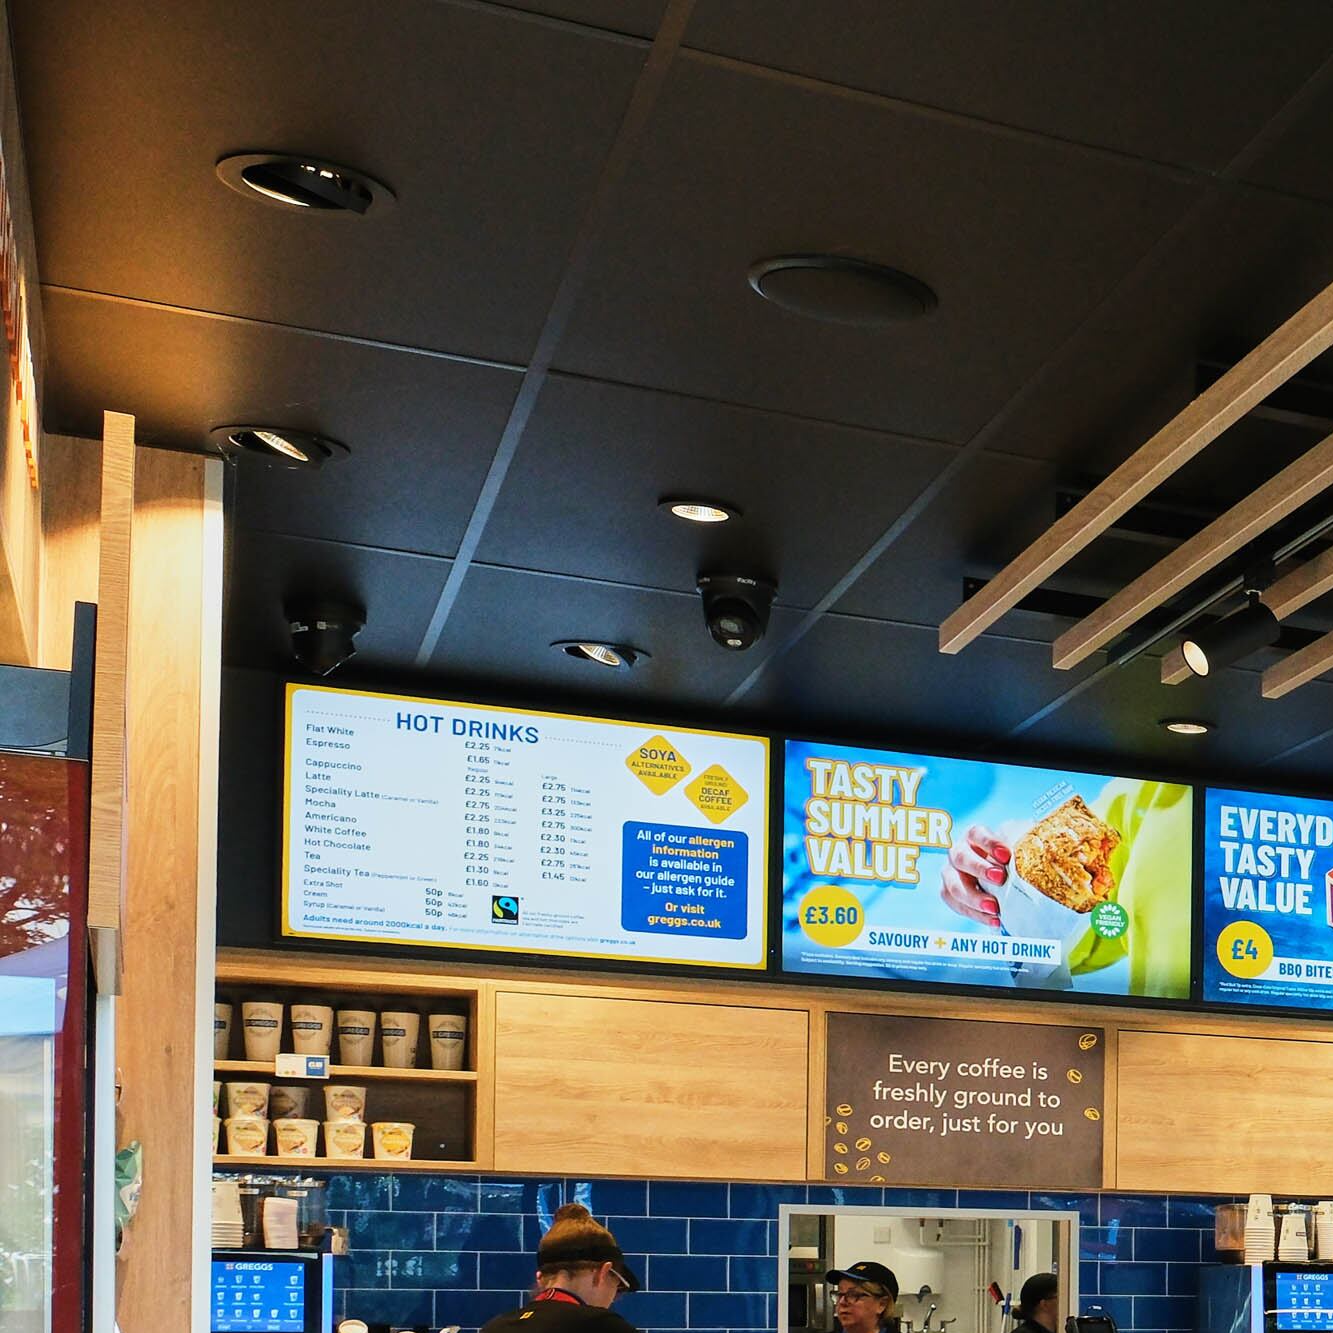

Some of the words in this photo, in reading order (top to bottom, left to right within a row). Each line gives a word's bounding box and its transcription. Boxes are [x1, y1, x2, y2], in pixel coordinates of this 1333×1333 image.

[305, 724, 326, 735] Flat
[327, 727, 355, 736] White
[396, 712, 444, 734] HOT
[452, 718, 539, 744] DRINKS
[305, 738, 351, 751] Espresso
[465, 741, 490, 751] £2.25
[467, 755, 490, 765] £1.65
[639, 748, 677, 762] SOYA
[305, 758, 362, 772] Cappuccino
[631, 760, 685, 773] ALTERNATIVES
[305, 772, 331, 782] Latte
[806, 758, 923, 807] TASTY
[304, 785, 352, 798] Speciality
[354, 789, 381, 800] Latte
[465, 787, 490, 797] £2.25
[542, 783, 566, 792] £2.75
[701, 787, 730, 797] DECAF
[304, 798, 336, 809] Mocha
[542, 795, 566, 805] £2.75
[698, 794, 733, 805] COFFEE
[304, 811, 357, 824] Americano
[464, 813, 490, 823] £2.25
[806, 798, 952, 848] SUMMER
[304, 825, 333, 836] White
[334, 827, 367, 839] Coffee
[542, 821, 566, 830] £2.75
[304, 838, 321, 848] Hot
[323, 840, 371, 851] Chocolate
[466, 839, 490, 849] £1.80
[540, 833, 565, 843] £2.30
[636, 830, 652, 841] All
[653, 831, 666, 842] of
[667, 834, 687, 844] our
[688, 835, 735, 850] allergen
[304, 851, 321, 861] Tea
[652, 843, 719, 860] information
[541, 859, 565, 868] £2.75
[649, 856, 659, 867] is
[660, 857, 710, 872] available
[712, 862, 722, 873] in
[806, 837, 920, 883] VALUE
[1220, 842, 1315, 880] TASTY
[304, 864, 352, 878] Speciality
[354, 868, 370, 878] Tea
[466, 865, 489, 875] £1.30
[303, 879, 324, 888] Extra
[325, 880, 343, 889] Shot
[635, 870, 655, 880] our
[656, 870, 702, 886] allergen
[704, 874, 735, 888] guide
[303, 889, 328, 898] Cream
[425, 887, 443, 898] 50p
[651, 882, 673, 895] just
[675, 884, 695, 897] ask
[697, 886, 713, 898] for
[714, 887, 728, 899] it.
[1219, 877, 1313, 915] VALUE
[303, 900, 325, 910] Syrup
[425, 897, 443, 908] 50p
[665, 902, 678, 913] Or
[680, 903, 705, 915] visit
[425, 908, 443, 919] 50p
[805, 905, 858, 927] £3.60
[1099, 914, 1122, 923] VEGAN
[303, 914, 330, 924] Adults
[331, 917, 353, 926] need
[354, 918, 384, 928] around
[385, 920, 424, 930] 2000kcal
[647, 915, 722, 929] greggs.co.uk
[869, 931, 929, 950] SAVOURY
[951, 938, 978, 954] ANY
[982, 939, 1008, 956] HOT
[1231, 939, 1258, 960] £4
[1279, 962, 1301, 978] BBQ
[889, 1054, 950, 1081] Every
[957, 1058, 1025, 1079] coffee
[1032, 1062, 1048, 1080] is
[873, 1081, 947, 1108] freshly
[954, 1088, 1031, 1112] ground
[1038, 1092, 1061, 1108] to
[870, 1111, 935, 1134] order,
[940, 1113, 981, 1136] just
[987, 1113, 1018, 1134] for
[1025, 1119, 1063, 1140] you
[235, 1263, 273, 1271] GREGGS
